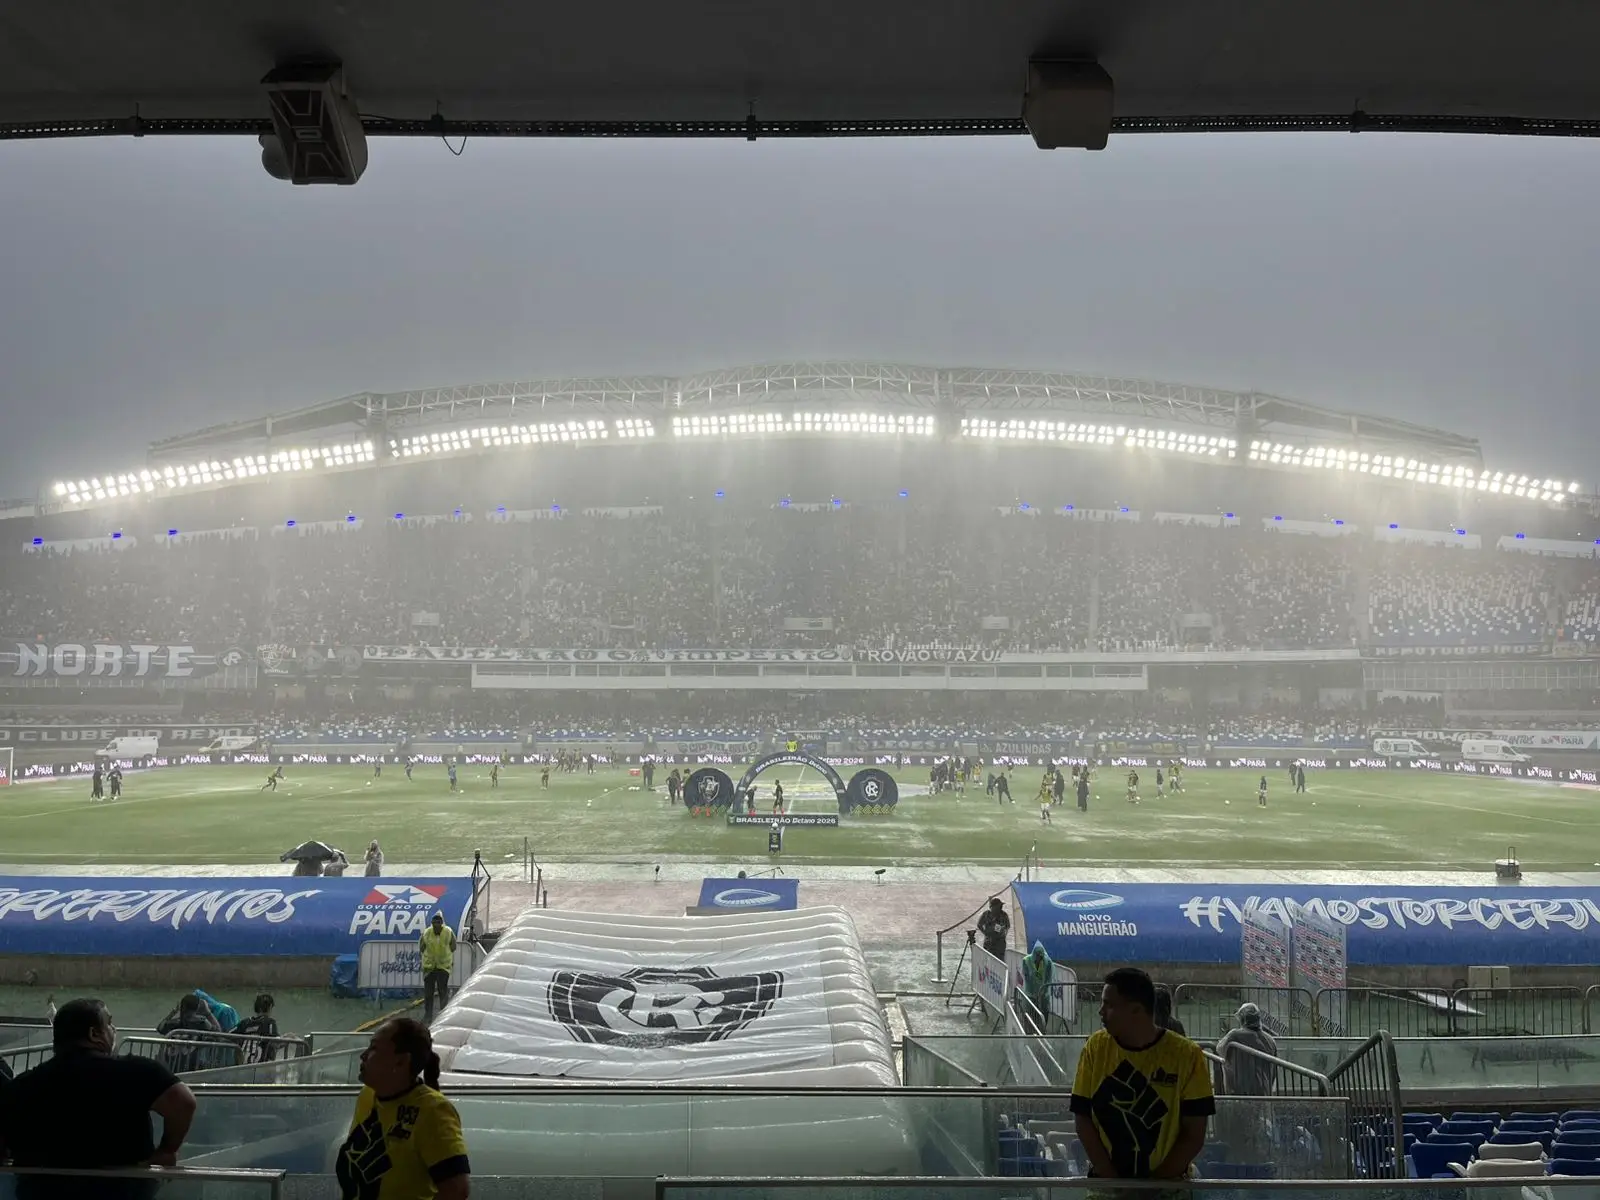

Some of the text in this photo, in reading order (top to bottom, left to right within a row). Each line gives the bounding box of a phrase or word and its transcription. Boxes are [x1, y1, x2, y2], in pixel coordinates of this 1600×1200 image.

[14, 642, 195, 676] NORTE
[172, 728, 242, 740] REMO
[843, 756, 864, 765] 2026
[736, 815, 791, 824] BRASILEIRÃO
[791, 816, 815, 824] Betano
[349, 909, 429, 935] PARÁ
[1079, 914, 1111, 922] NOVO
[1057, 919, 1137, 937] MANGUEIRÃO
